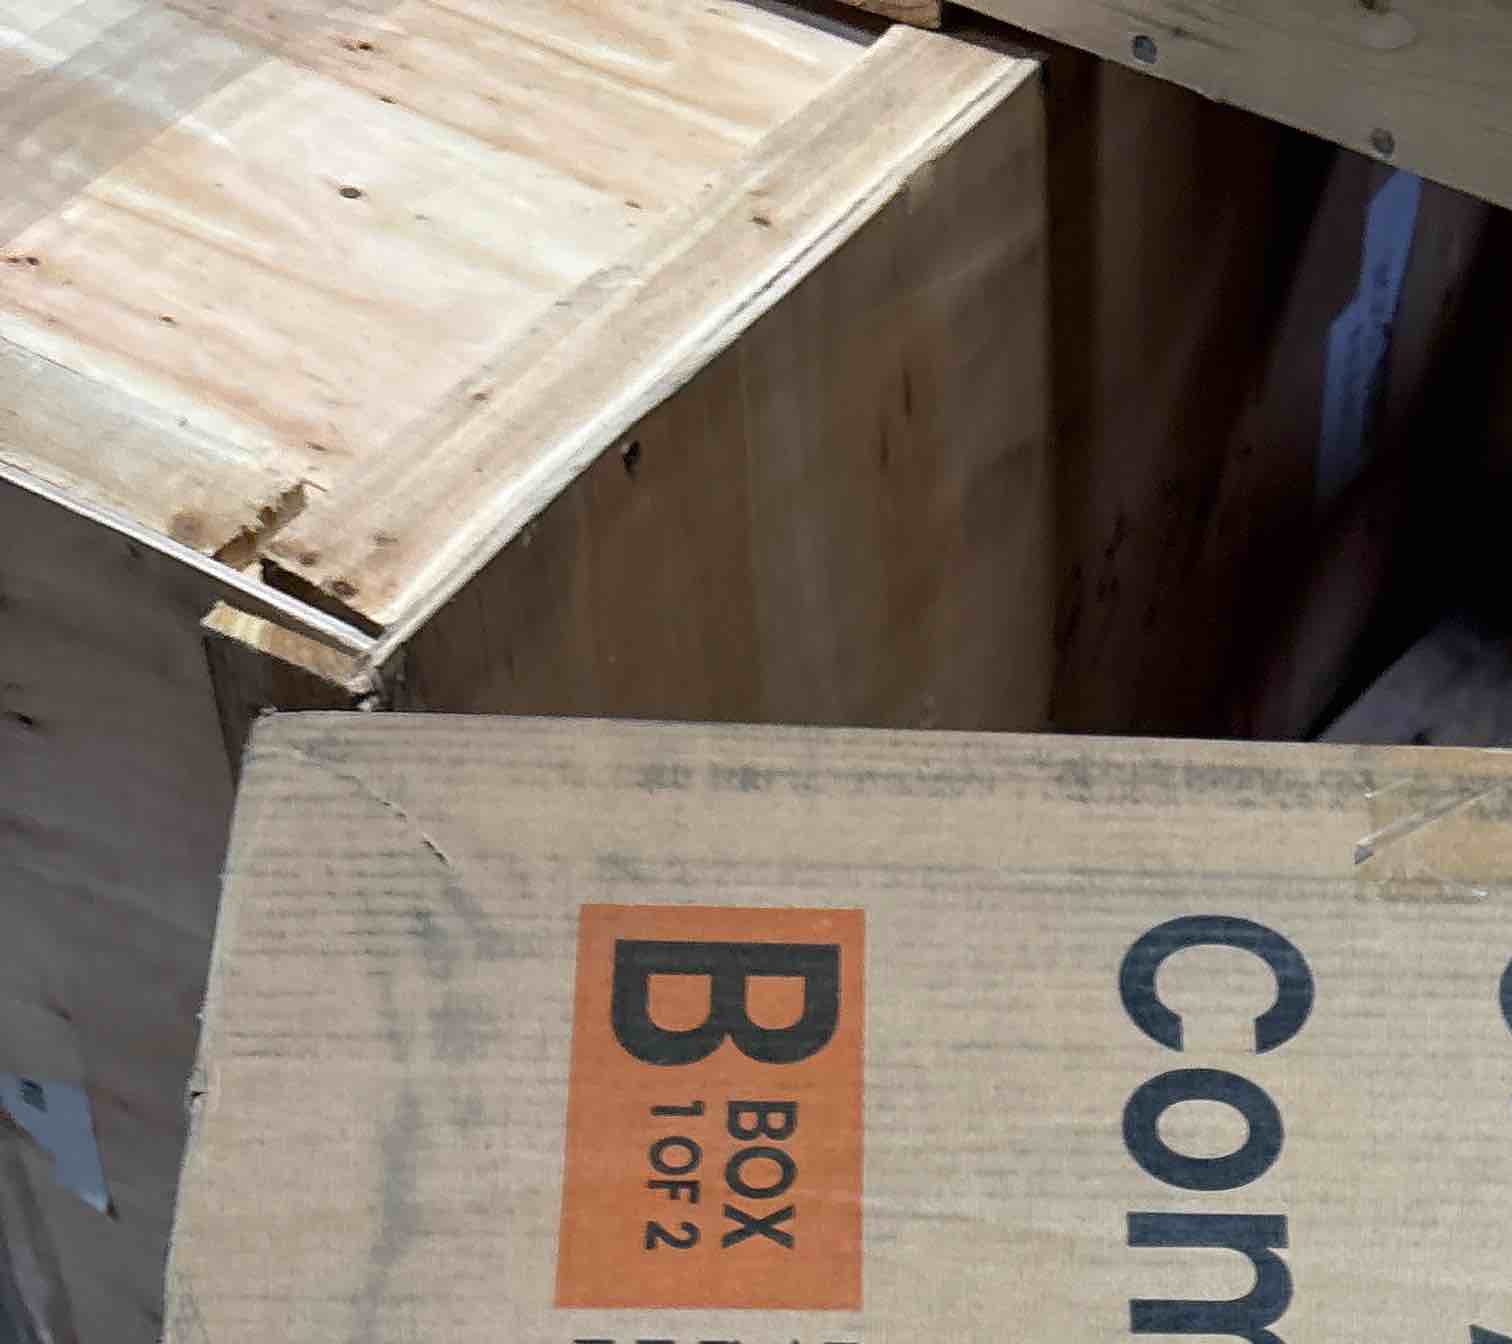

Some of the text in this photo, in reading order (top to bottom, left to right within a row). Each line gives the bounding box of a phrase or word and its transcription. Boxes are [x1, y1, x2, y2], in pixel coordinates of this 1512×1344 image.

[611, 939, 843, 1067] B
[643, 1100, 705, 1252] 1 OF 2
[720, 1100, 799, 1250] BOX
